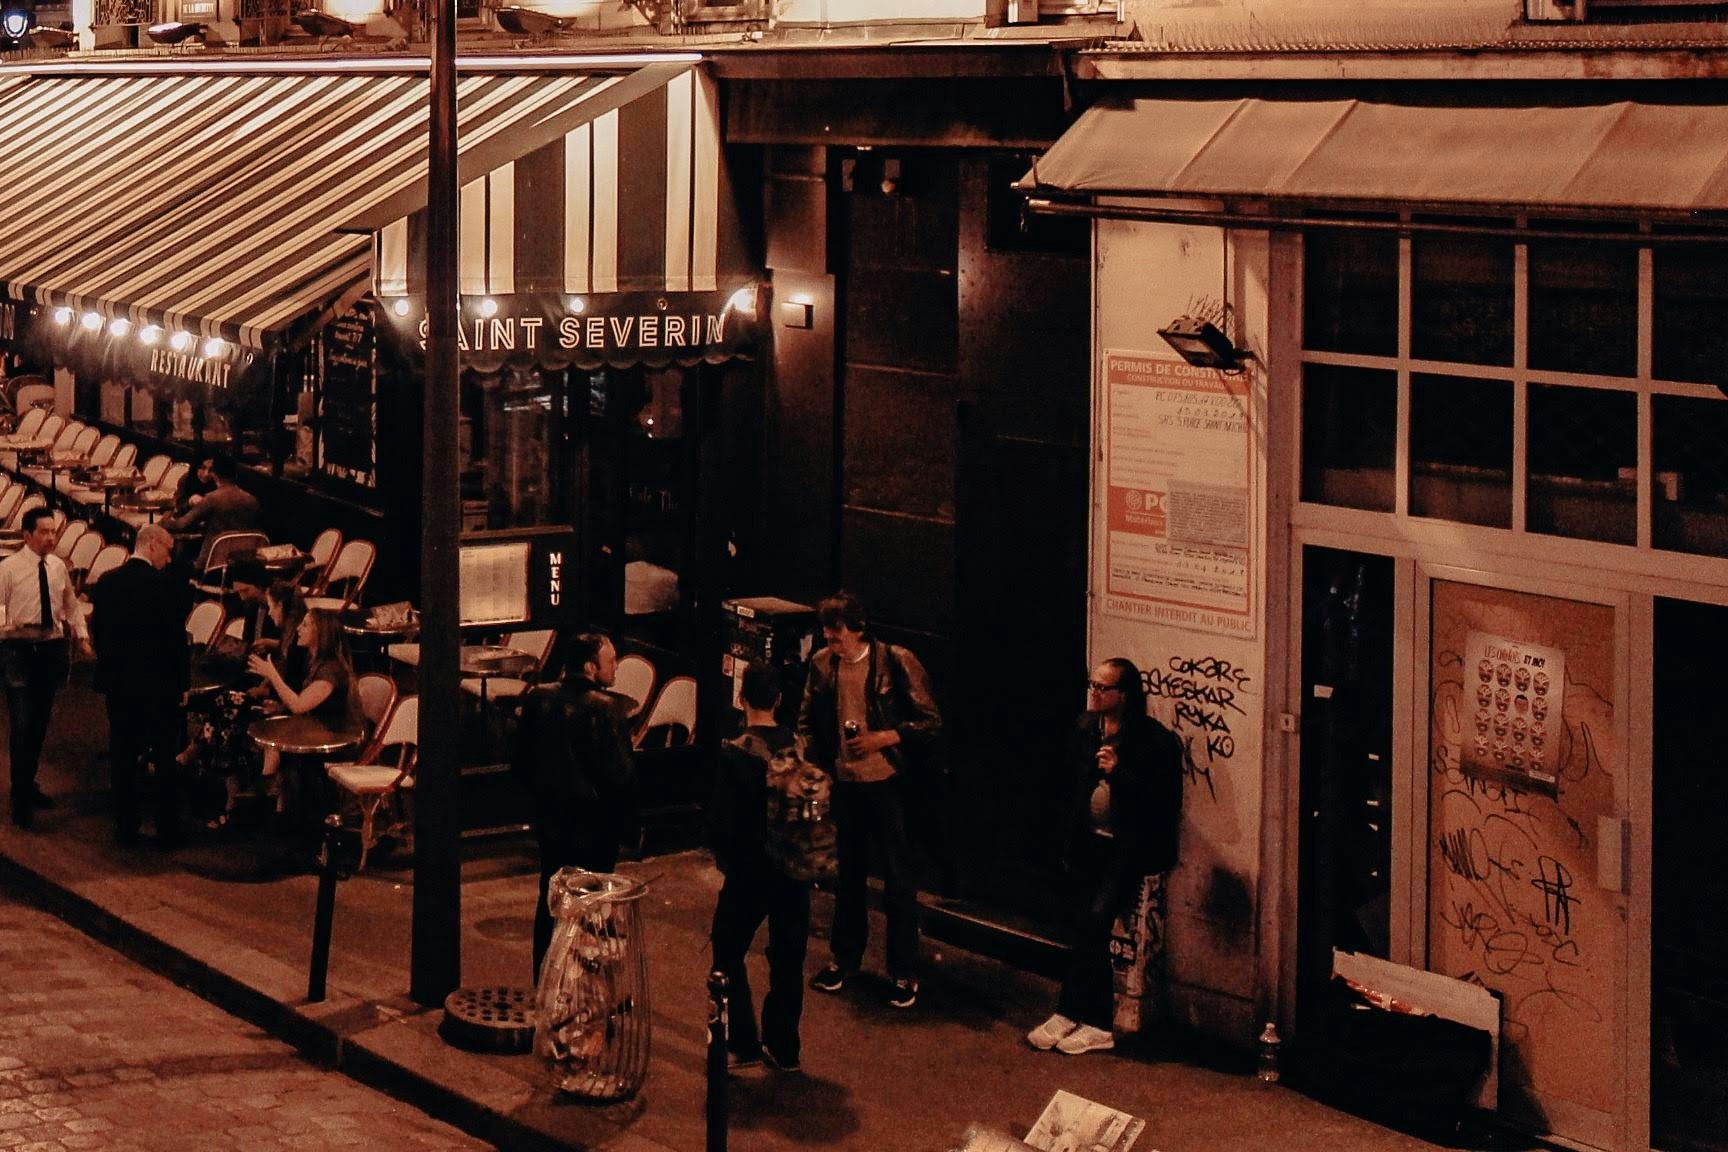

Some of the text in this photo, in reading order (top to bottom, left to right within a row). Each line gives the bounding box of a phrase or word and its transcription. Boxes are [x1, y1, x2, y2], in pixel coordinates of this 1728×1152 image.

[559, 313, 726, 349] SEVERIN
[150, 348, 231, 389] RESTAURANT
[1110, 359, 1152, 373] PERMIS
[1156, 364, 1169, 376] DE
[550, 552, 562, 606] MENU
[1106, 599, 1152, 615] CHANTIER
[1155, 607, 1197, 623] INTERDIT
[1217, 617, 1250, 631] PUBLIC
